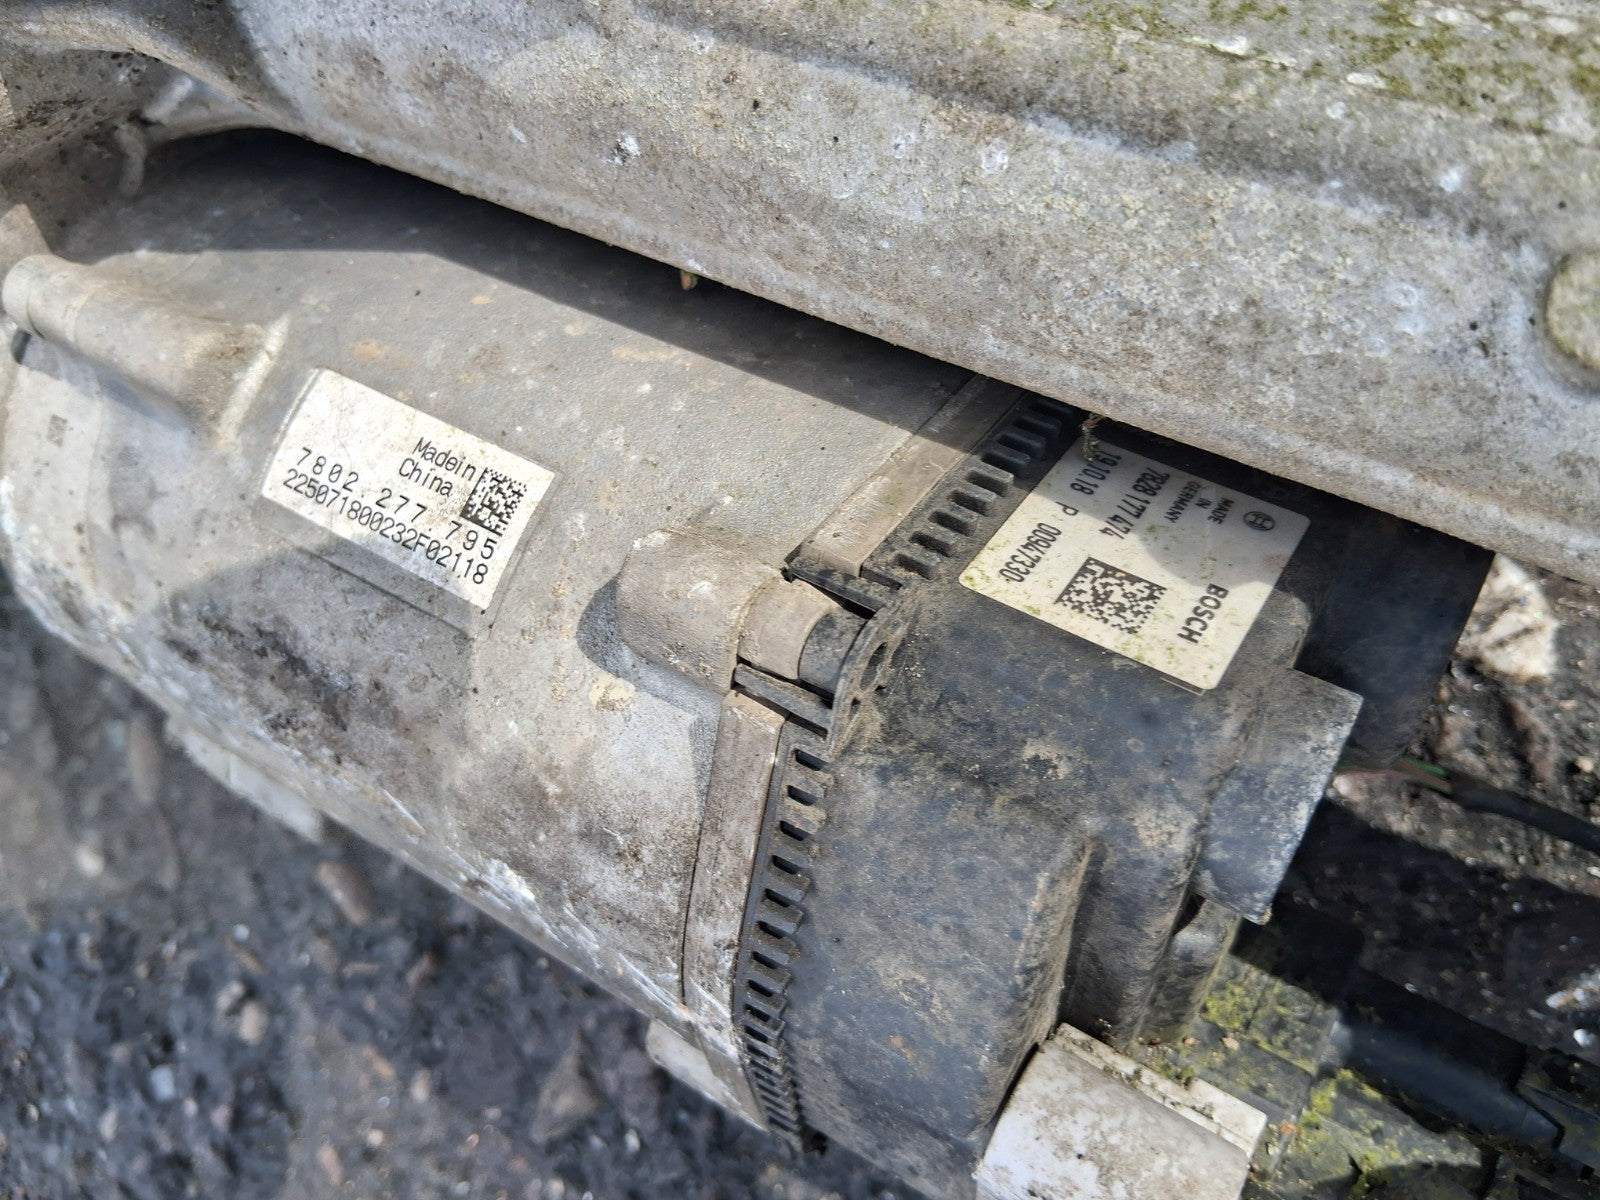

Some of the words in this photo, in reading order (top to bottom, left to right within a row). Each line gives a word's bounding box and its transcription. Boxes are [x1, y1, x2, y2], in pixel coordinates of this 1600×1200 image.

[398, 457, 453, 497] China
[1069, 449, 1122, 495] 1910.18
[1054, 501, 1080, 516] P
[1116, 493, 1151, 519] 177
[1164, 481, 1201, 524] GERMANY
[1194, 497, 1212, 509] IN
[1207, 497, 1235, 525] MADE
[282, 468, 489, 585] 225071800232F02118
[1098, 514, 1134, 539] 474
[998, 522, 1063, 583] 00947330
[1177, 583, 1229, 644] BOSCH
